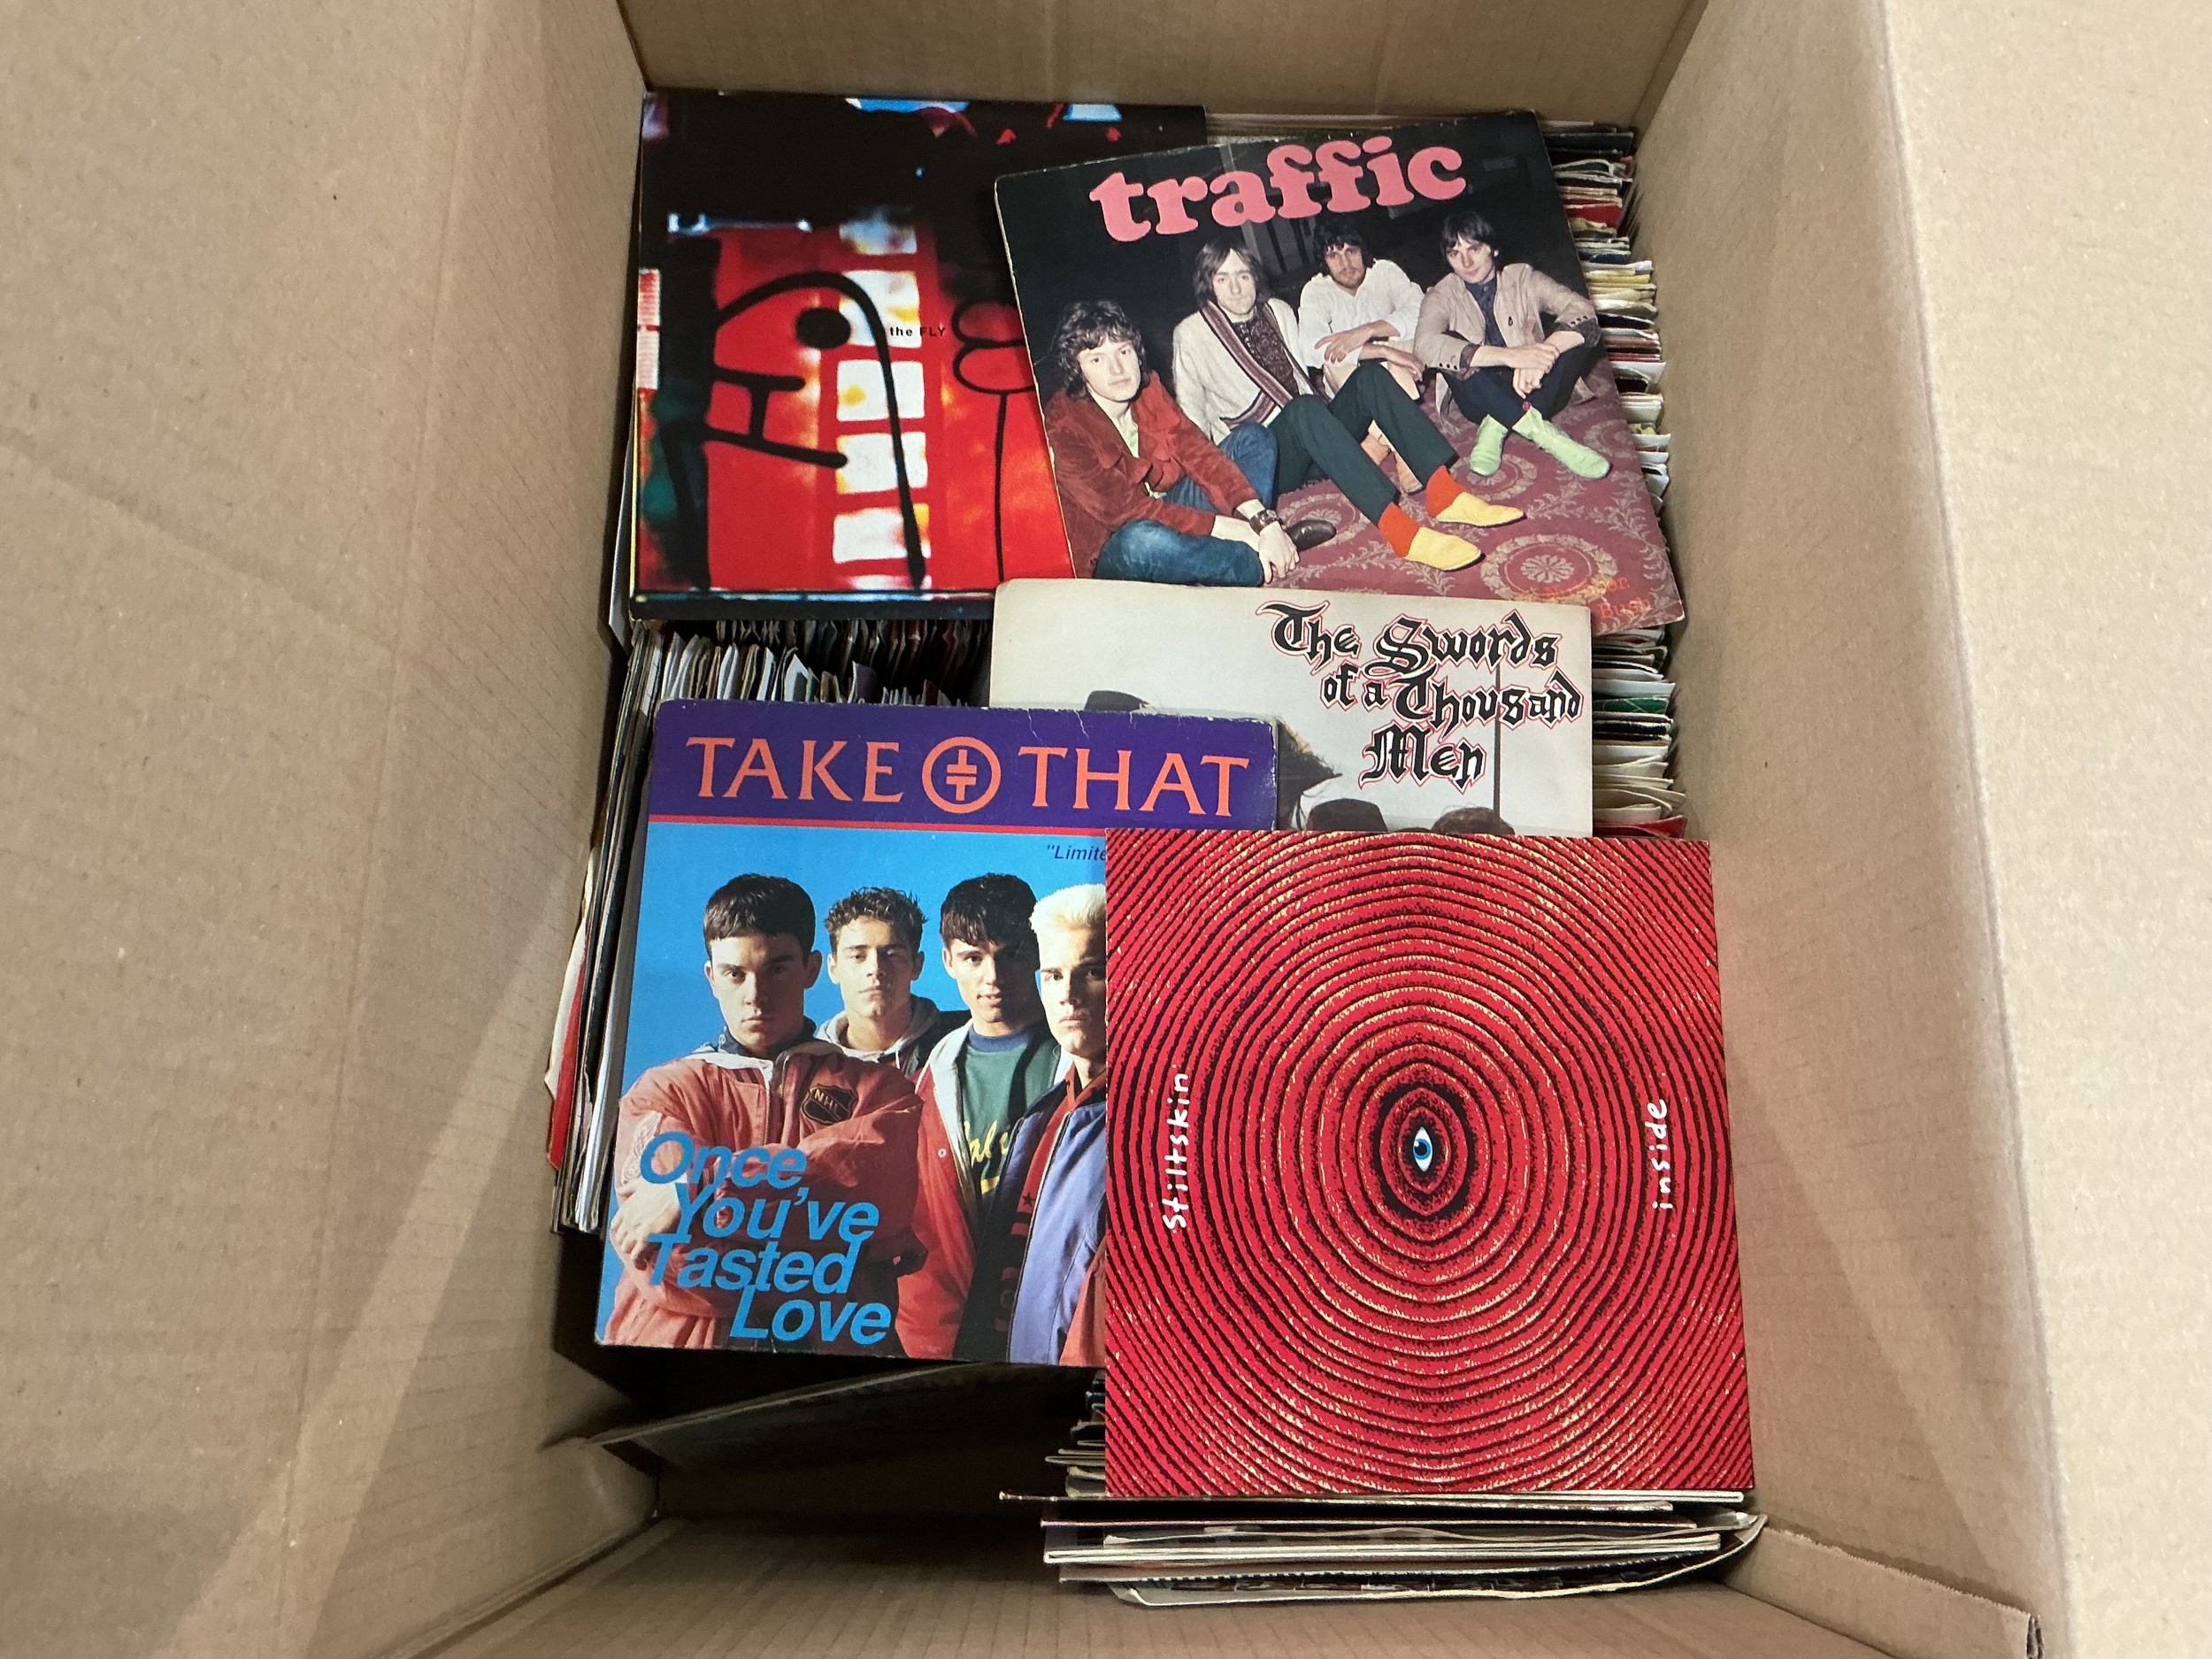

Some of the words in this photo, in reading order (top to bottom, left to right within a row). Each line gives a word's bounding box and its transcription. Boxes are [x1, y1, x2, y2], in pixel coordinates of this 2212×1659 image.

[1089, 135, 1466, 242] traffic
[889, 326, 913, 336] the
[920, 326, 945, 336] FLY
[1256, 600, 1362, 674] The
[1363, 609, 1562, 681] Swords
[1319, 660, 1361, 710] of
[1363, 679, 1391, 711] a
[1387, 664, 1586, 744] Thousand
[686, 736, 903, 803] TAKE
[1018, 747, 1249, 817] THAT
[1359, 719, 1487, 794] Men
[640, 1131, 807, 1190] Once
[1645, 1099, 1673, 1209] inside
[675, 1182, 879, 1243] You've
[648, 1233, 862, 1294] Tasted
[729, 1284, 892, 1346] Love
